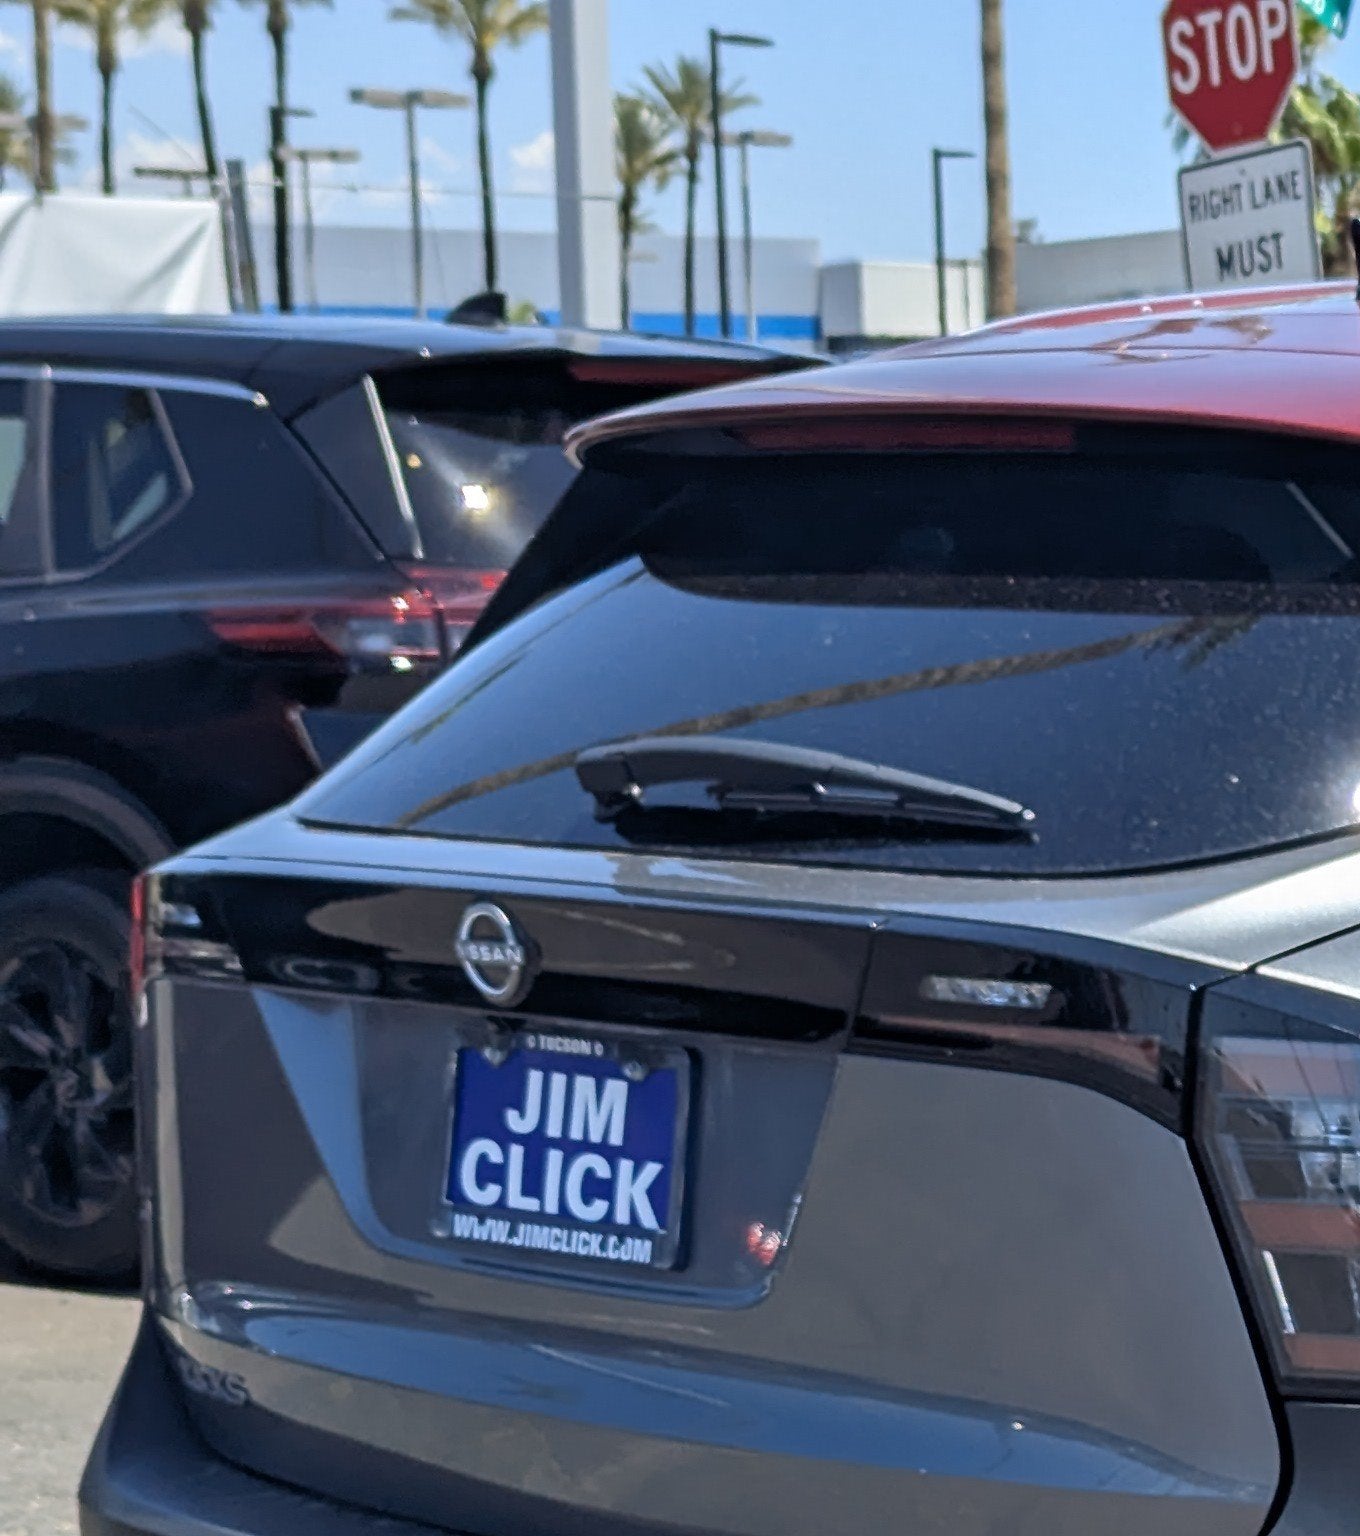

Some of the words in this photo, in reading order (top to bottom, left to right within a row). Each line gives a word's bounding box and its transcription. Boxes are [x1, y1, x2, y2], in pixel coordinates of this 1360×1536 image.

[1167, 1, 1288, 94] STOP
[1188, 182, 1244, 223] RIGHT
[1250, 169, 1303, 210] LANE
[1215, 231, 1284, 282] MUST
[539, 1033, 592, 1055] TUCSON
[504, 1068, 629, 1147] JIM
[459, 1137, 668, 1234] CLICK
[453, 1212, 653, 1264] WWW.JIMCLICK.COM
